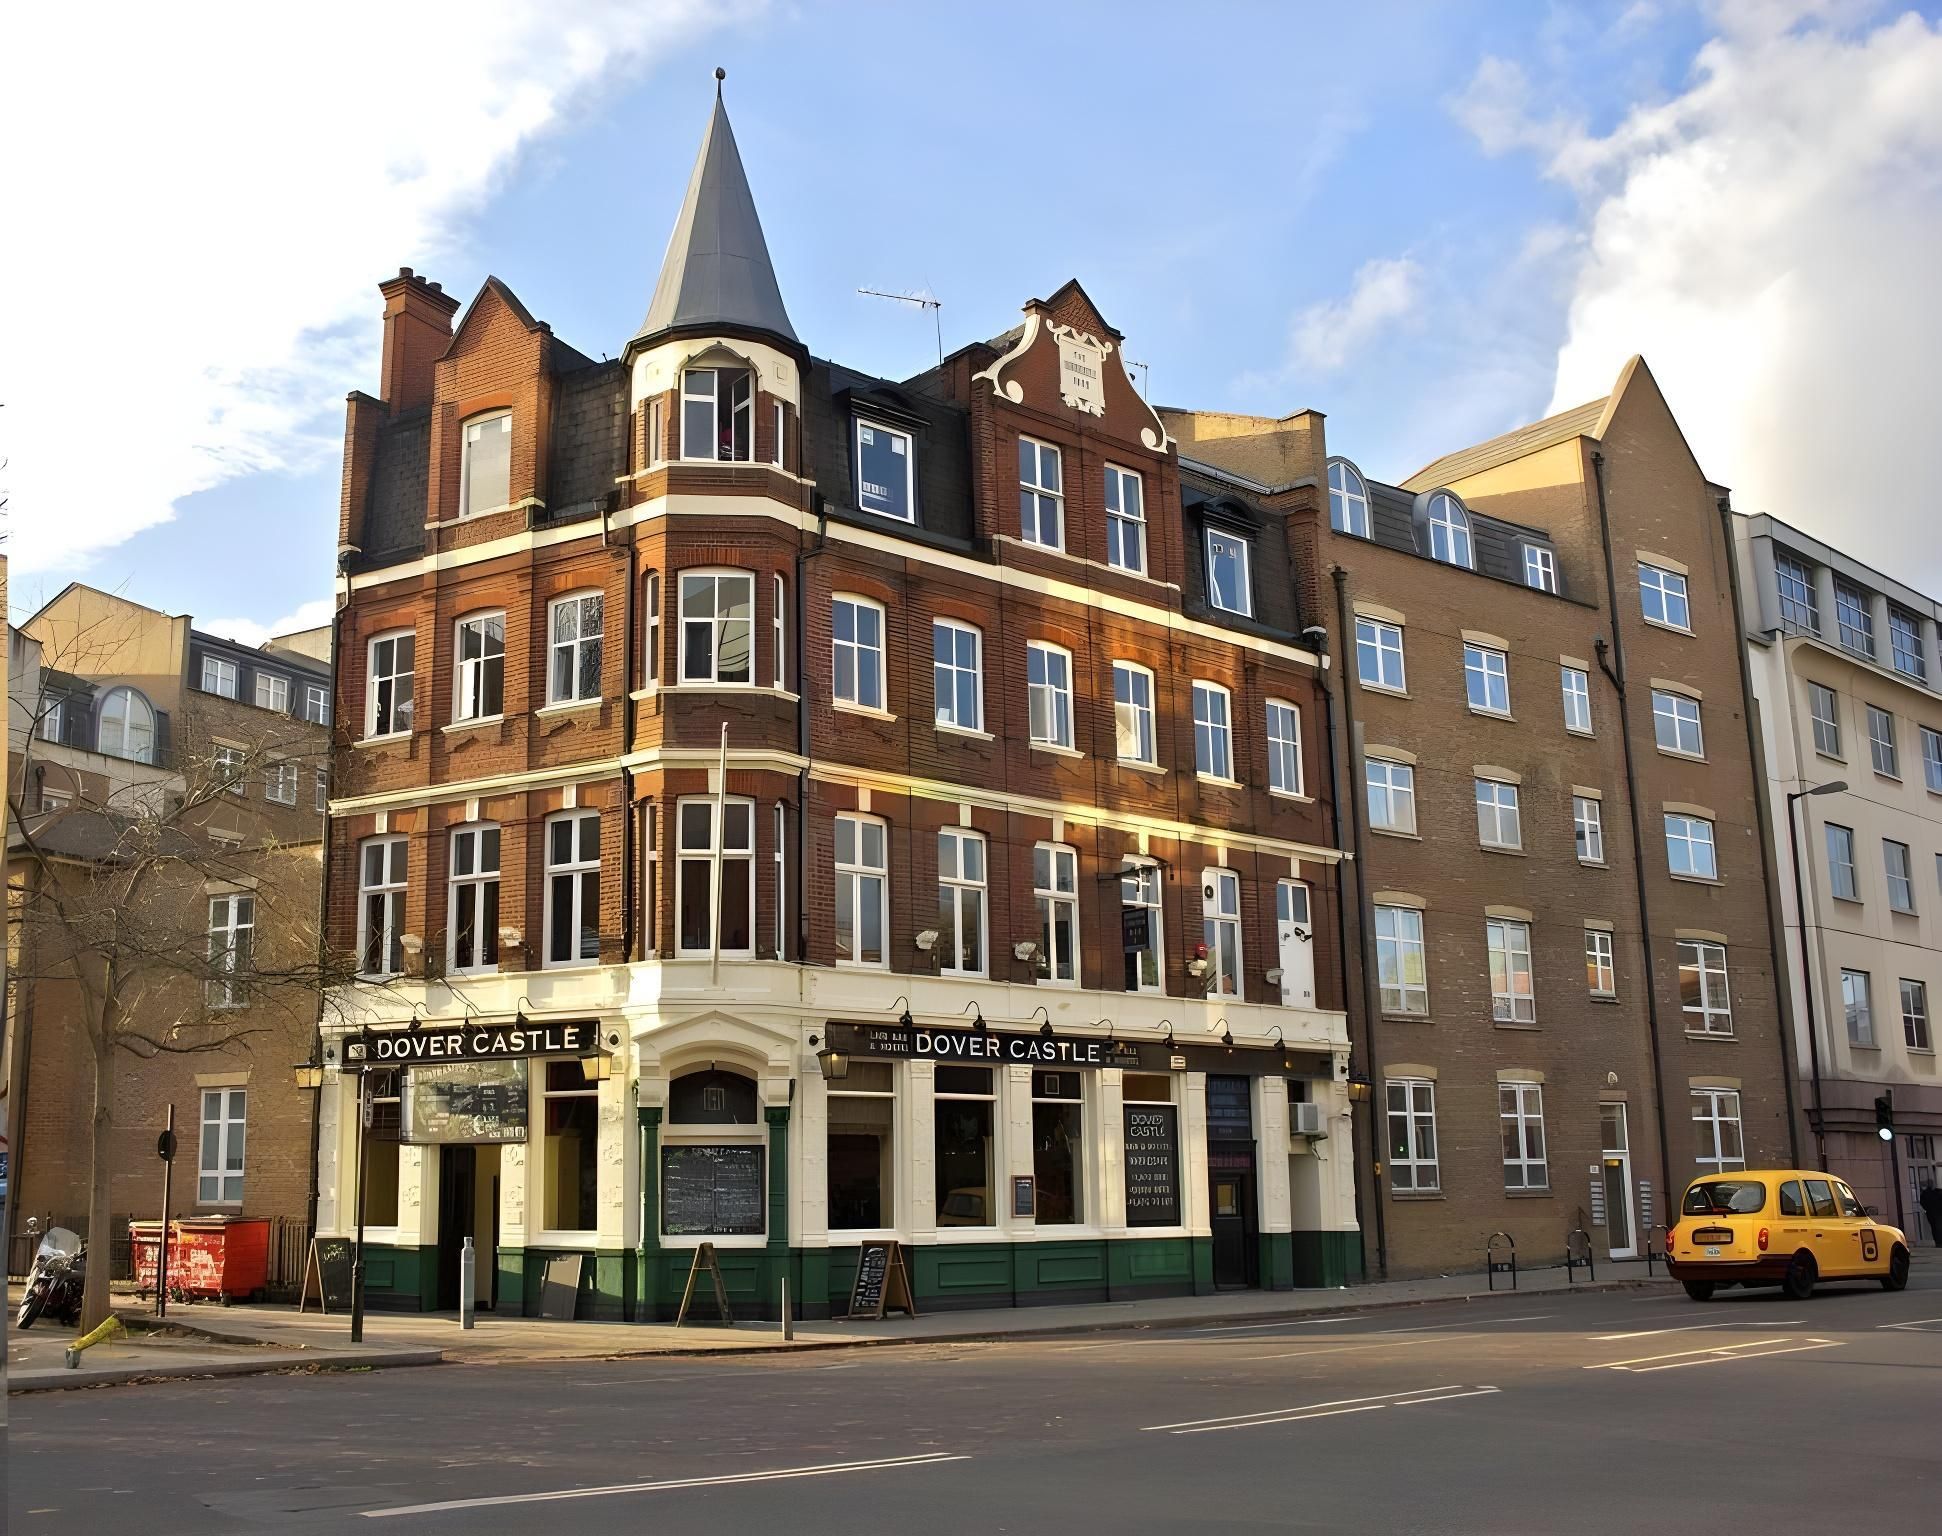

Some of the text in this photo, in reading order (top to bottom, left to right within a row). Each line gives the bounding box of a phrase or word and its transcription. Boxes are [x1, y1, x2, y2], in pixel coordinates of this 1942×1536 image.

[377, 1028, 580, 1058] DOVER CASTLE
[916, 1033, 1000, 1057] DOVER
[1009, 1039, 1100, 1062] CASTLE
